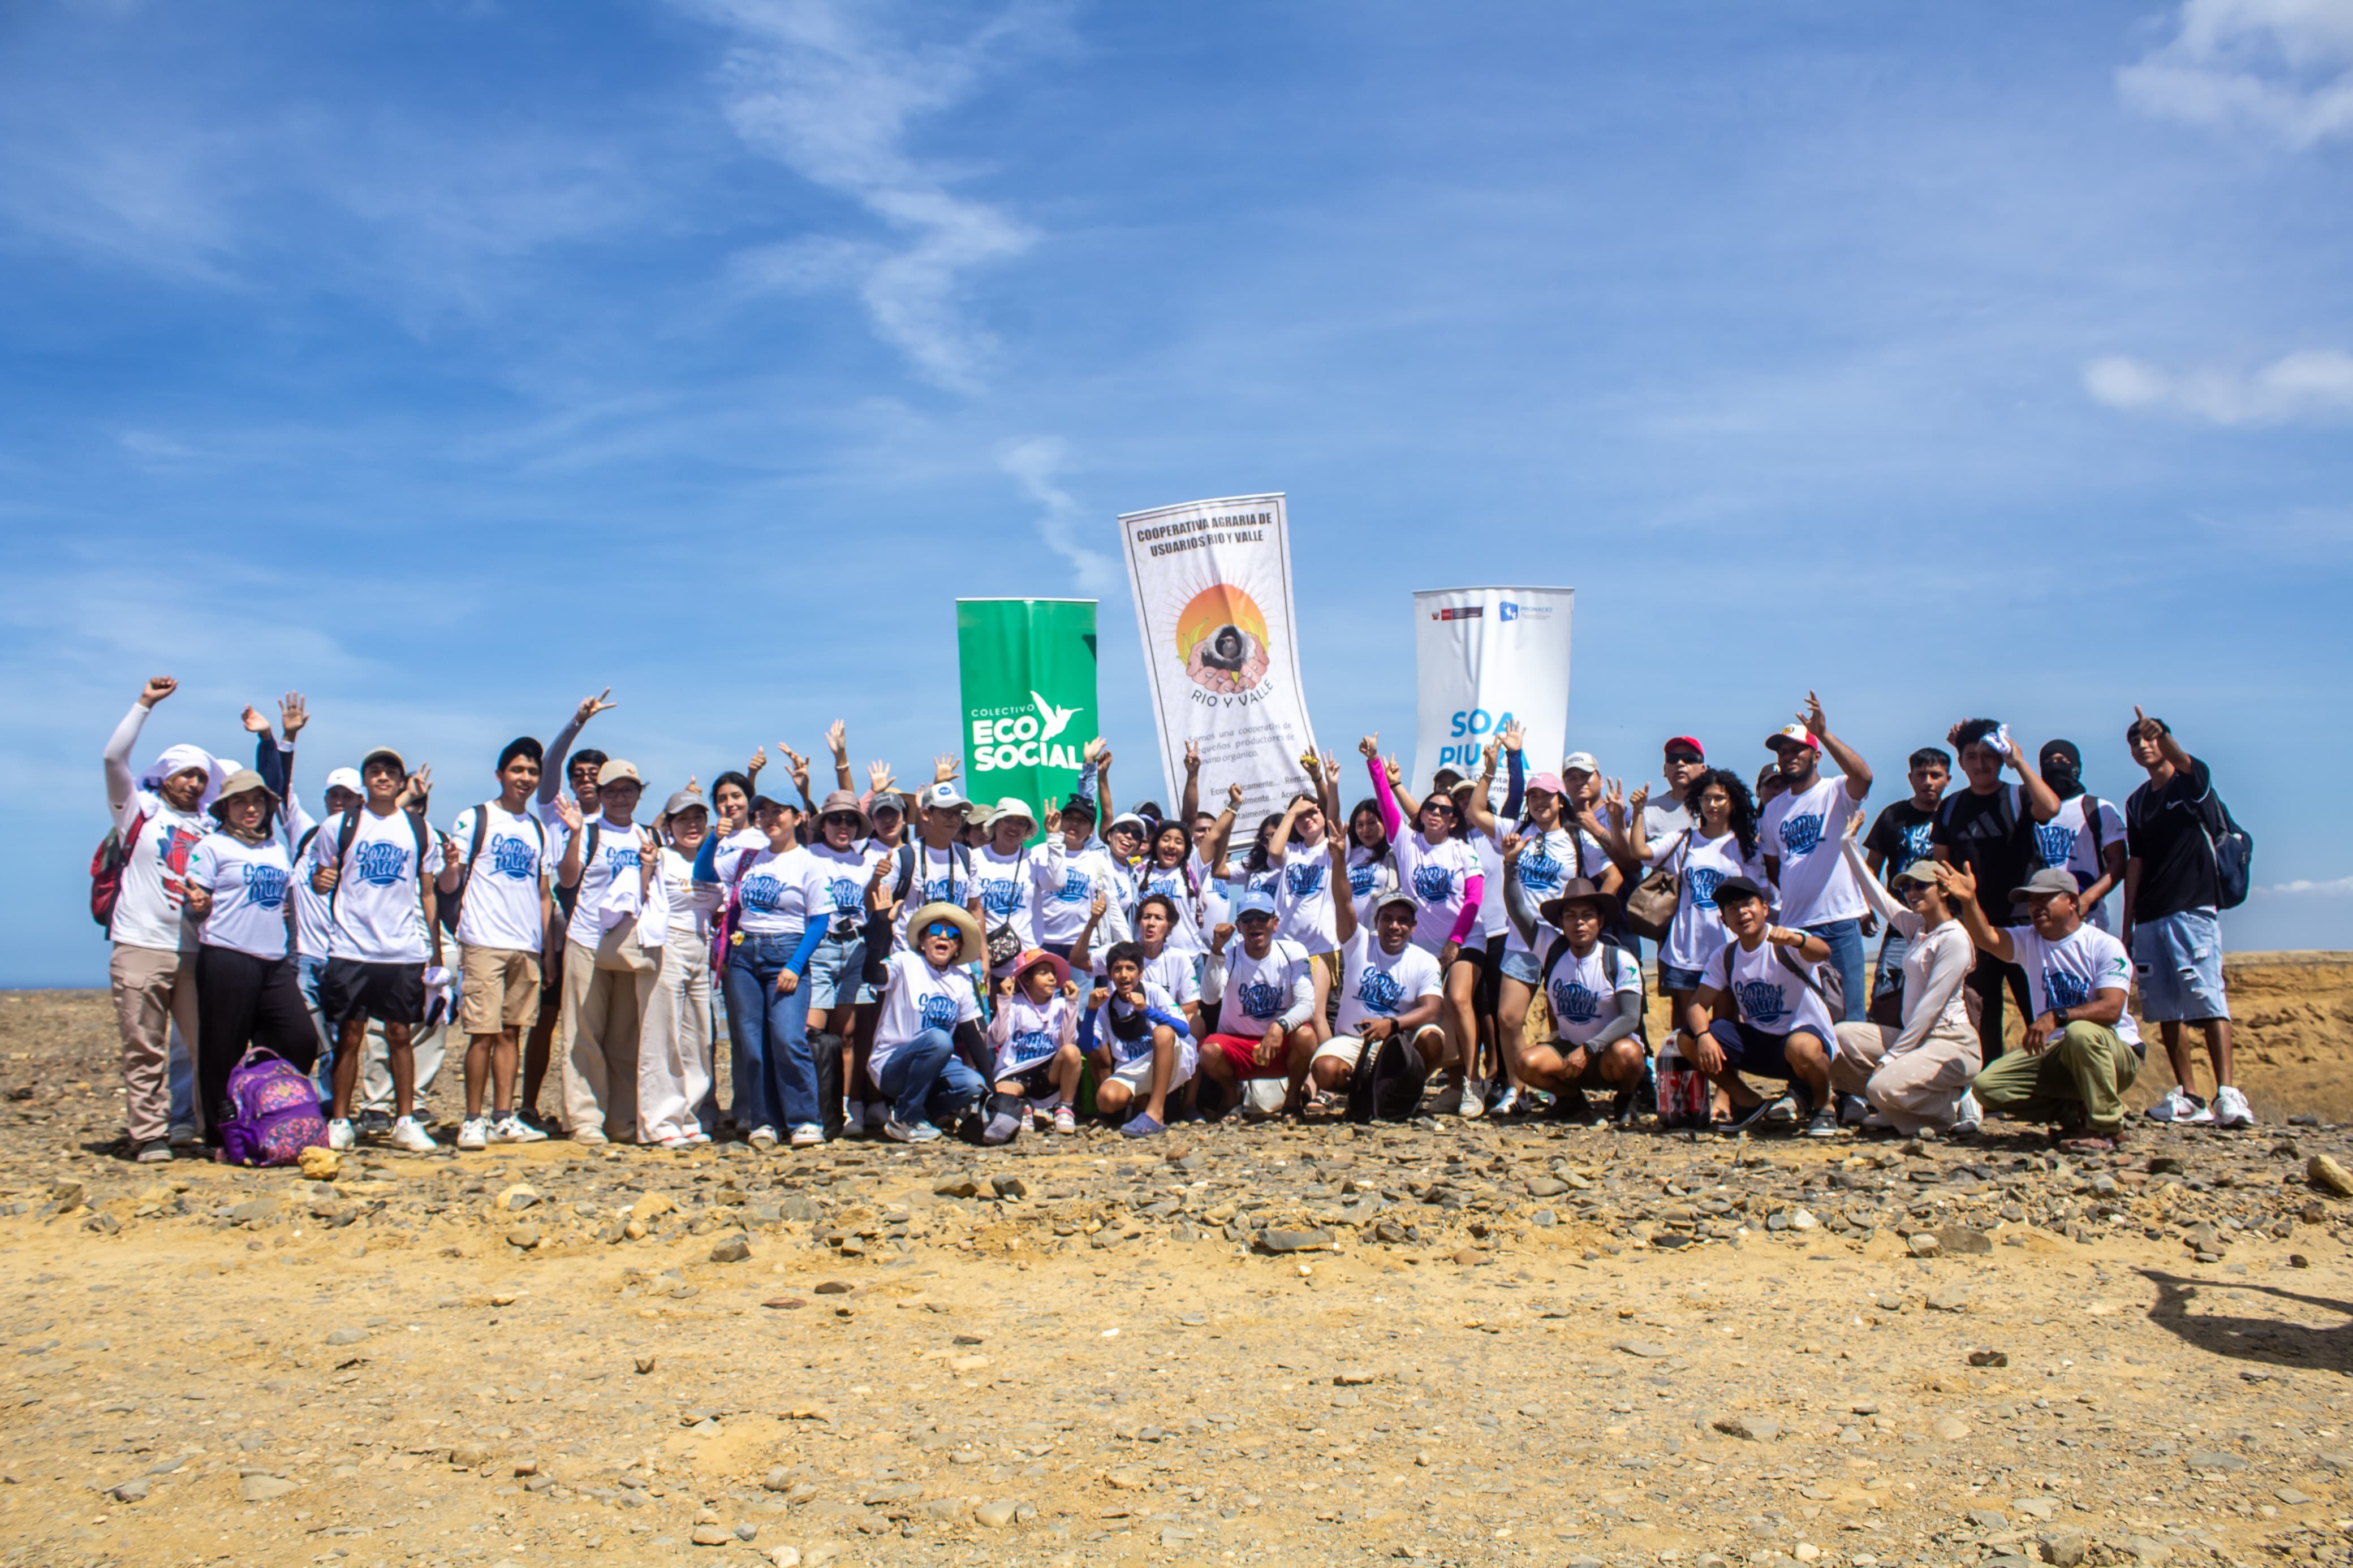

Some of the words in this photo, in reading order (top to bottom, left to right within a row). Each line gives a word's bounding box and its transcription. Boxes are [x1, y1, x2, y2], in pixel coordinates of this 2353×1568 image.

[1137, 519, 1209, 542] COOPERATIVA
[1212, 514, 1256, 529] AGRARIA
[1259, 512, 1272, 524] DE
[1150, 536, 1206, 557] USUARIOS
[1207, 533, 1225, 545] RIO
[1227, 532, 1232, 542] Y
[1235, 530, 1264, 543] VALLE
[1192, 689, 1217, 707] RIO
[1223, 698, 1232, 707] Y
[1238, 679, 1273, 706] VALLE
[971, 704, 1035, 717] COLECTIVO
[1451, 709, 1515, 737] SOA
[972, 715, 1038, 745] ECO
[1219, 729, 1234, 738] una
[974, 741, 1083, 771] SOCIAL
